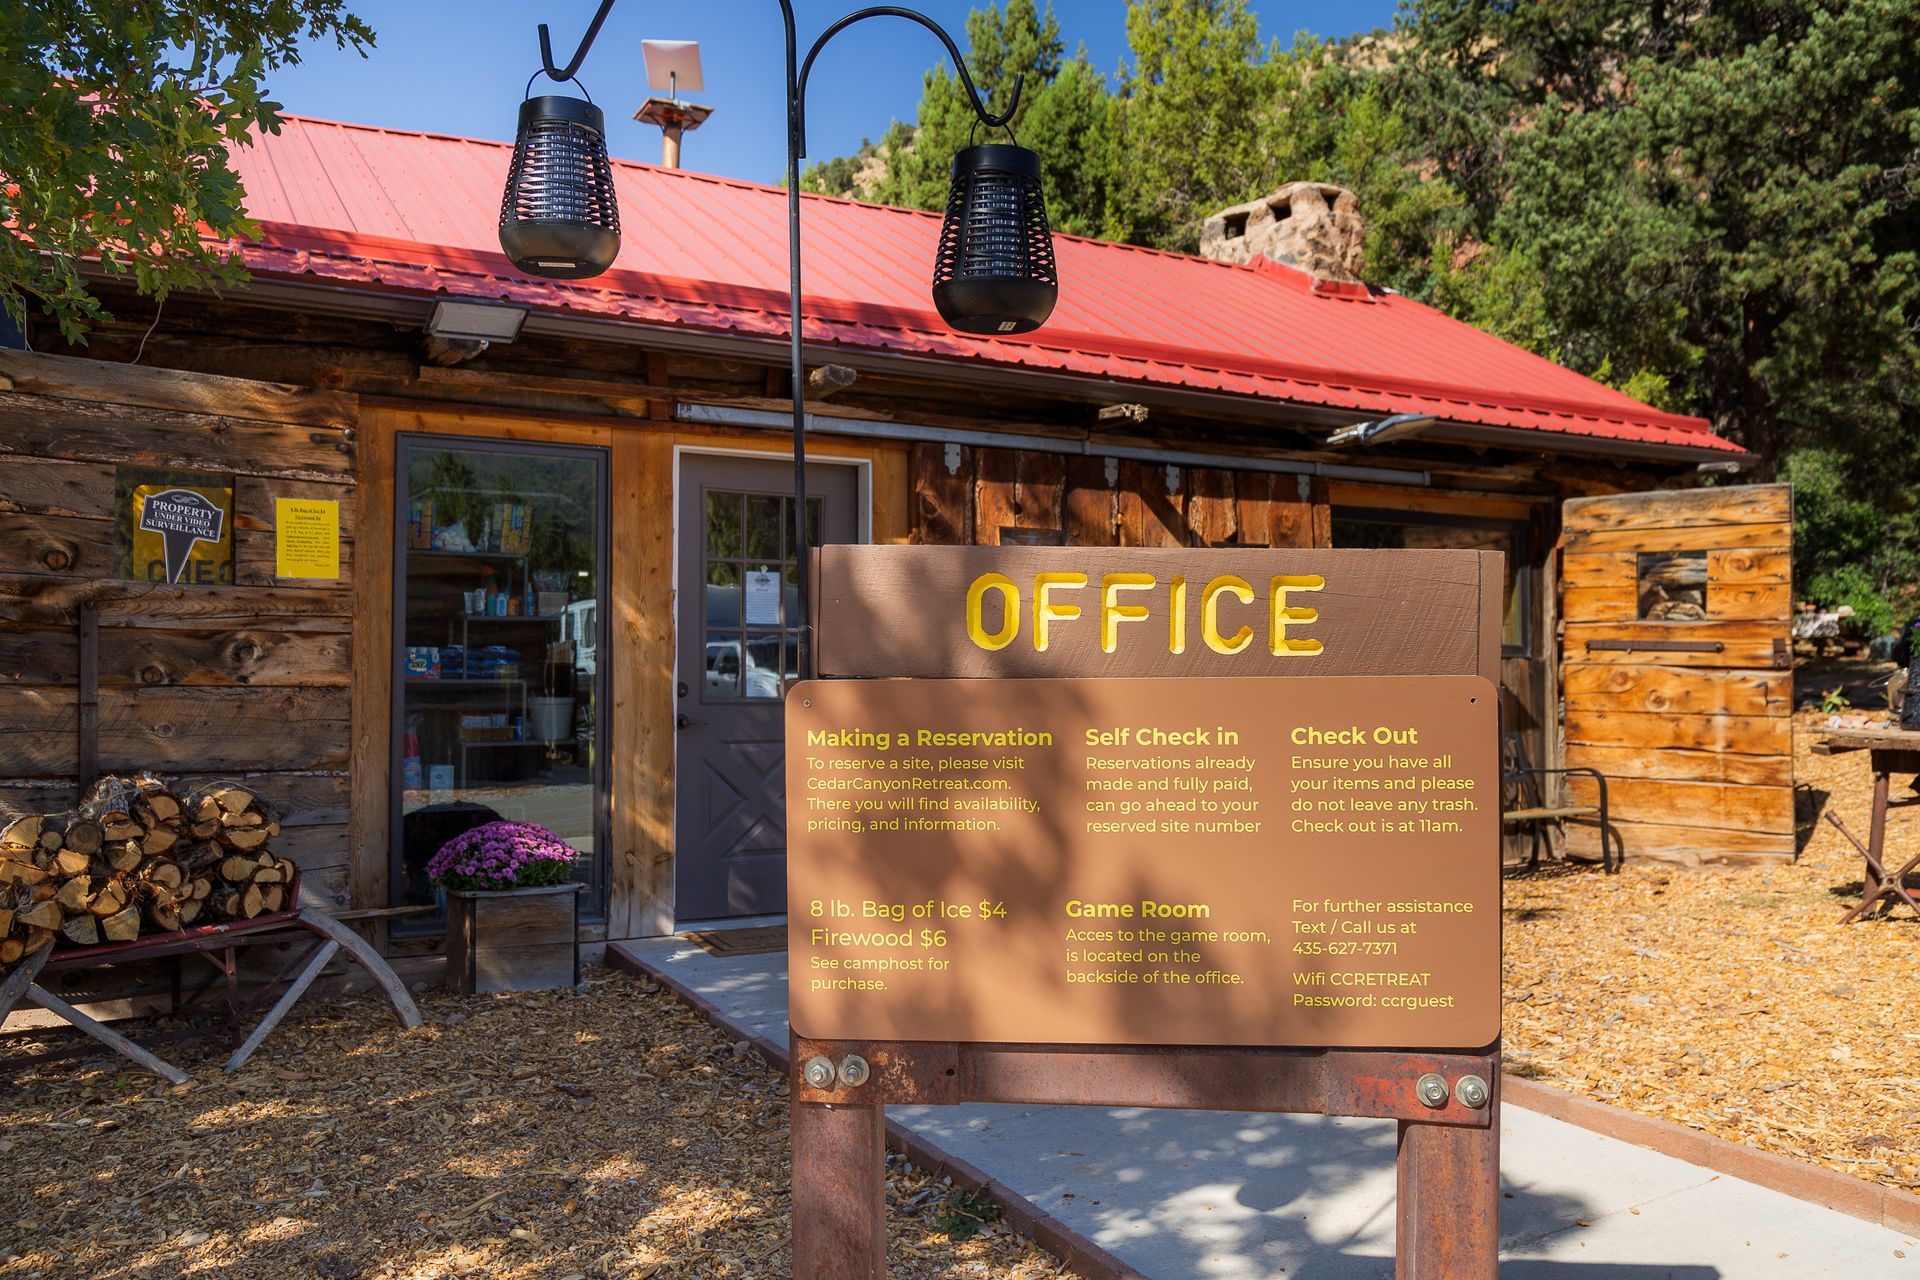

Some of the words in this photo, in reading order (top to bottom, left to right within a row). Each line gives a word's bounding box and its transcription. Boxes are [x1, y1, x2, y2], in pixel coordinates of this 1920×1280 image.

[152, 500, 215, 519] PROPERTY
[145, 518, 216, 538] SURVEILLANCE
[154, 511, 183, 523] UNDER
[185, 516, 211, 528] VIDEO
[967, 570, 1325, 657] OFFICE
[806, 727, 891, 752] Making
[896, 732, 910, 747] a
[917, 727, 1053, 747] Reservation
[1084, 727, 1131, 747] Self
[1135, 726, 1211, 747] Check
[1216, 725, 1240, 746] in
[1290, 725, 1367, 746] Check
[1372, 726, 1419, 745] Out
[806, 756, 825, 770] To
[829, 759, 886, 770] reserve
[889, 759, 899, 770] a
[902, 756, 934, 772] site,
[938, 756, 989, 773] please
[992, 755, 1025, 770] visit
[1086, 755, 1191, 770] Reservations
[1195, 755, 1256, 773] already
[1291, 755, 1349, 769] Ensure
[1352, 758, 1384, 772] you
[1388, 754, 1429, 769] have
[1432, 753, 1452, 769] all
[807, 777, 1012, 793] CedarCanyonRetreat.com.
[1086, 777, 1133, 791] made
[1137, 776, 1169, 791] and
[1173, 777, 1209, 793] fully
[1213, 776, 1253, 793] paid,
[1290, 779, 1329, 794] your
[1333, 776, 1380, 790] items
[1383, 776, 1416, 790] and
[1420, 776, 1475, 793] please
[806, 797, 851, 810] There
[854, 800, 883, 813] you
[887, 796, 914, 811] will
[918, 796, 949, 811] find
[954, 796, 1041, 813] availability,
[1085, 800, 1116, 812] can
[1119, 801, 1142, 815] go
[1145, 797, 1196, 812] ahead
[1200, 799, 1218, 812] to
[1221, 800, 1260, 815] your
[1290, 797, 1313, 812] do
[1317, 799, 1346, 811] not
[1350, 797, 1393, 812] leave
[1397, 800, 1428, 814] any
[1431, 797, 1479, 812] trash.
[807, 817, 866, 834] pricing,
[869, 817, 900, 831] and
[903, 817, 1000, 831] information.
[1086, 818, 1157, 833] reserved
[1160, 816, 1190, 833] site
[1194, 818, 1262, 833] number
[1291, 818, 1344, 833] Check
[1348, 819, 1377, 833] out
[1381, 818, 1395, 833] is
[1398, 819, 1416, 833] at
[1418, 818, 1463, 833] 11am.
[810, 899, 824, 917] 8
[830, 897, 855, 918] lb.
[862, 900, 905, 922] Bag
[911, 899, 935, 918] of
[940, 900, 973, 919] Ice
[978, 898, 1008, 921] $4
[1065, 899, 1135, 918] Game
[1141, 900, 1211, 919] Room
[1292, 899, 1320, 913] For
[1323, 898, 1383, 913] further
[1386, 898, 1474, 913] assistance
[1291, 920, 1326, 934] Text
[1330, 918, 1338, 935] /
[1341, 919, 1371, 934] Call
[1376, 923, 1396, 934] us
[1400, 921, 1417, 934] at
[811, 928, 913, 948] Firewood
[920, 927, 947, 950] $6
[1065, 928, 1114, 942] Acces
[1117, 929, 1135, 942] to
[1137, 928, 1167, 942] the
[1170, 931, 1219, 945] game
[1221, 931, 1271, 945] room,
[1066, 948, 1079, 963] is
[1083, 948, 1143, 963] located
[1147, 952, 1169, 963] on
[1172, 949, 1201, 963] the
[1292, 940, 1397, 955] 435-627-7371
[810, 956, 839, 969] See
[843, 956, 924, 973] camphost
[927, 956, 950, 971] for
[811, 976, 888, 992] purchase.
[1066, 969, 1139, 984] backside
[1142, 969, 1160, 984] of
[1162, 970, 1191, 984] the
[1194, 970, 1244, 985] office.
[1292, 971, 1325, 986] Wifi
[1330, 972, 1432, 987] CCRETREAT
[1293, 993, 1377, 1007] Password:
[1381, 995, 1455, 1011] ccrguest
